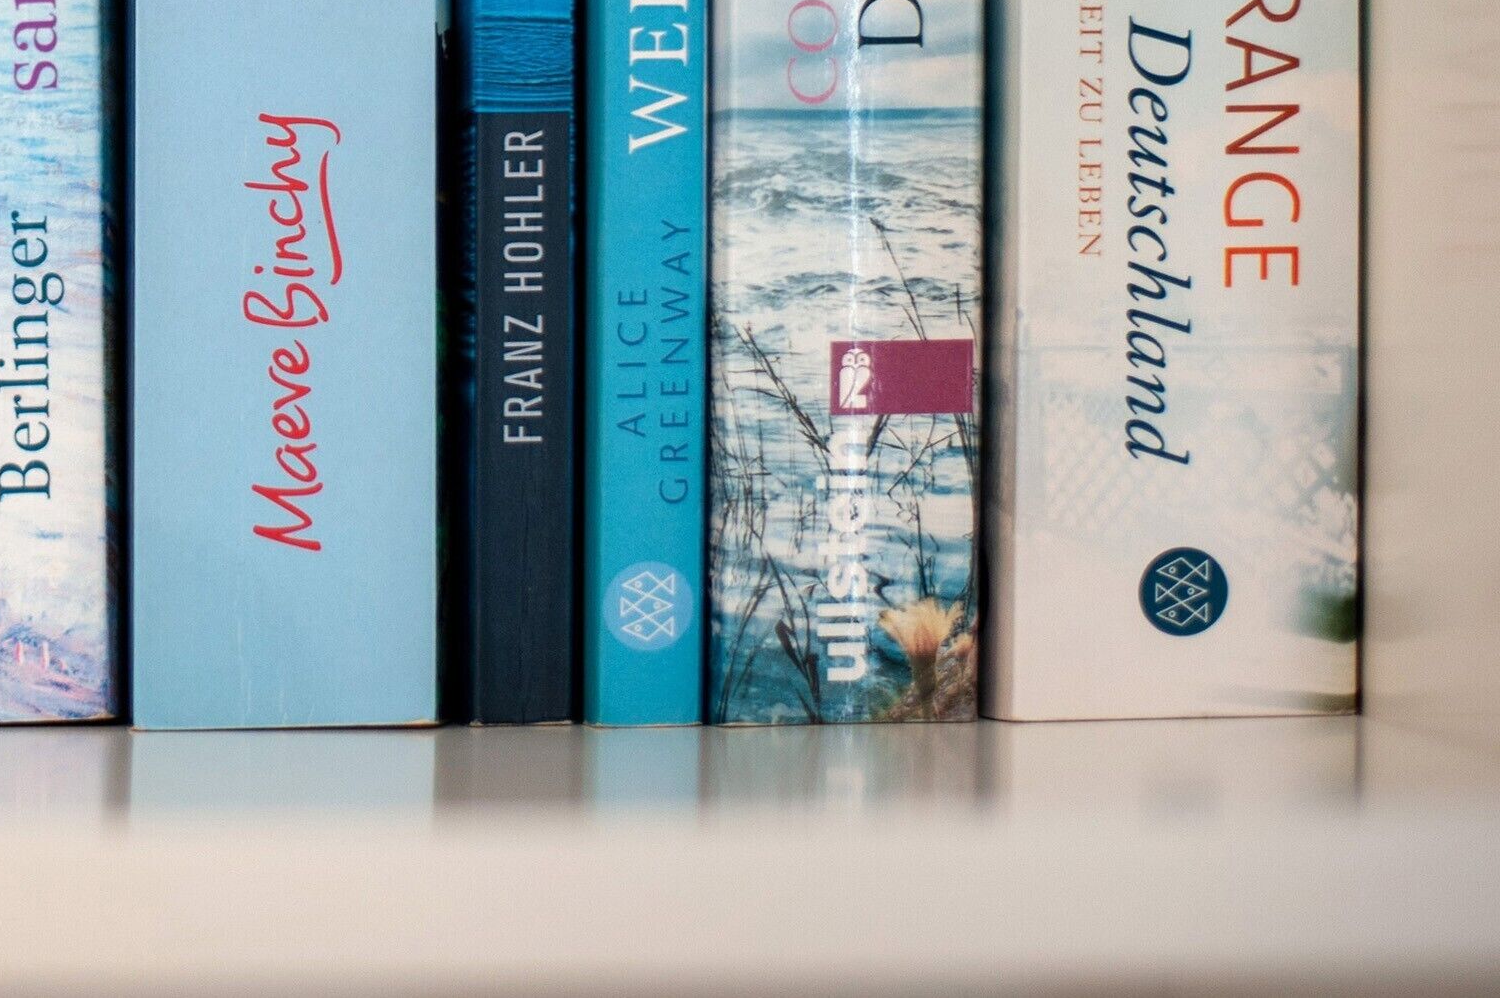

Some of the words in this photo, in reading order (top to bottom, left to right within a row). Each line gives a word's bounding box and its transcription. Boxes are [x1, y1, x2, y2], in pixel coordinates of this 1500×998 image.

[1077, 78, 1104, 125] ZU
[243, 112, 342, 328] Binchy
[503, 127, 544, 293] HOHLER
[1077, 139, 1103, 258] LEBEN
[1125, 15, 1193, 465] Deutschland
[251, 339, 324, 552] Maeve
[503, 313, 544, 444] FRANZ
[617, 286, 649, 438] ALICE
[660, 218, 692, 504] GREENWAY
[816, 430, 869, 683] ullstein
